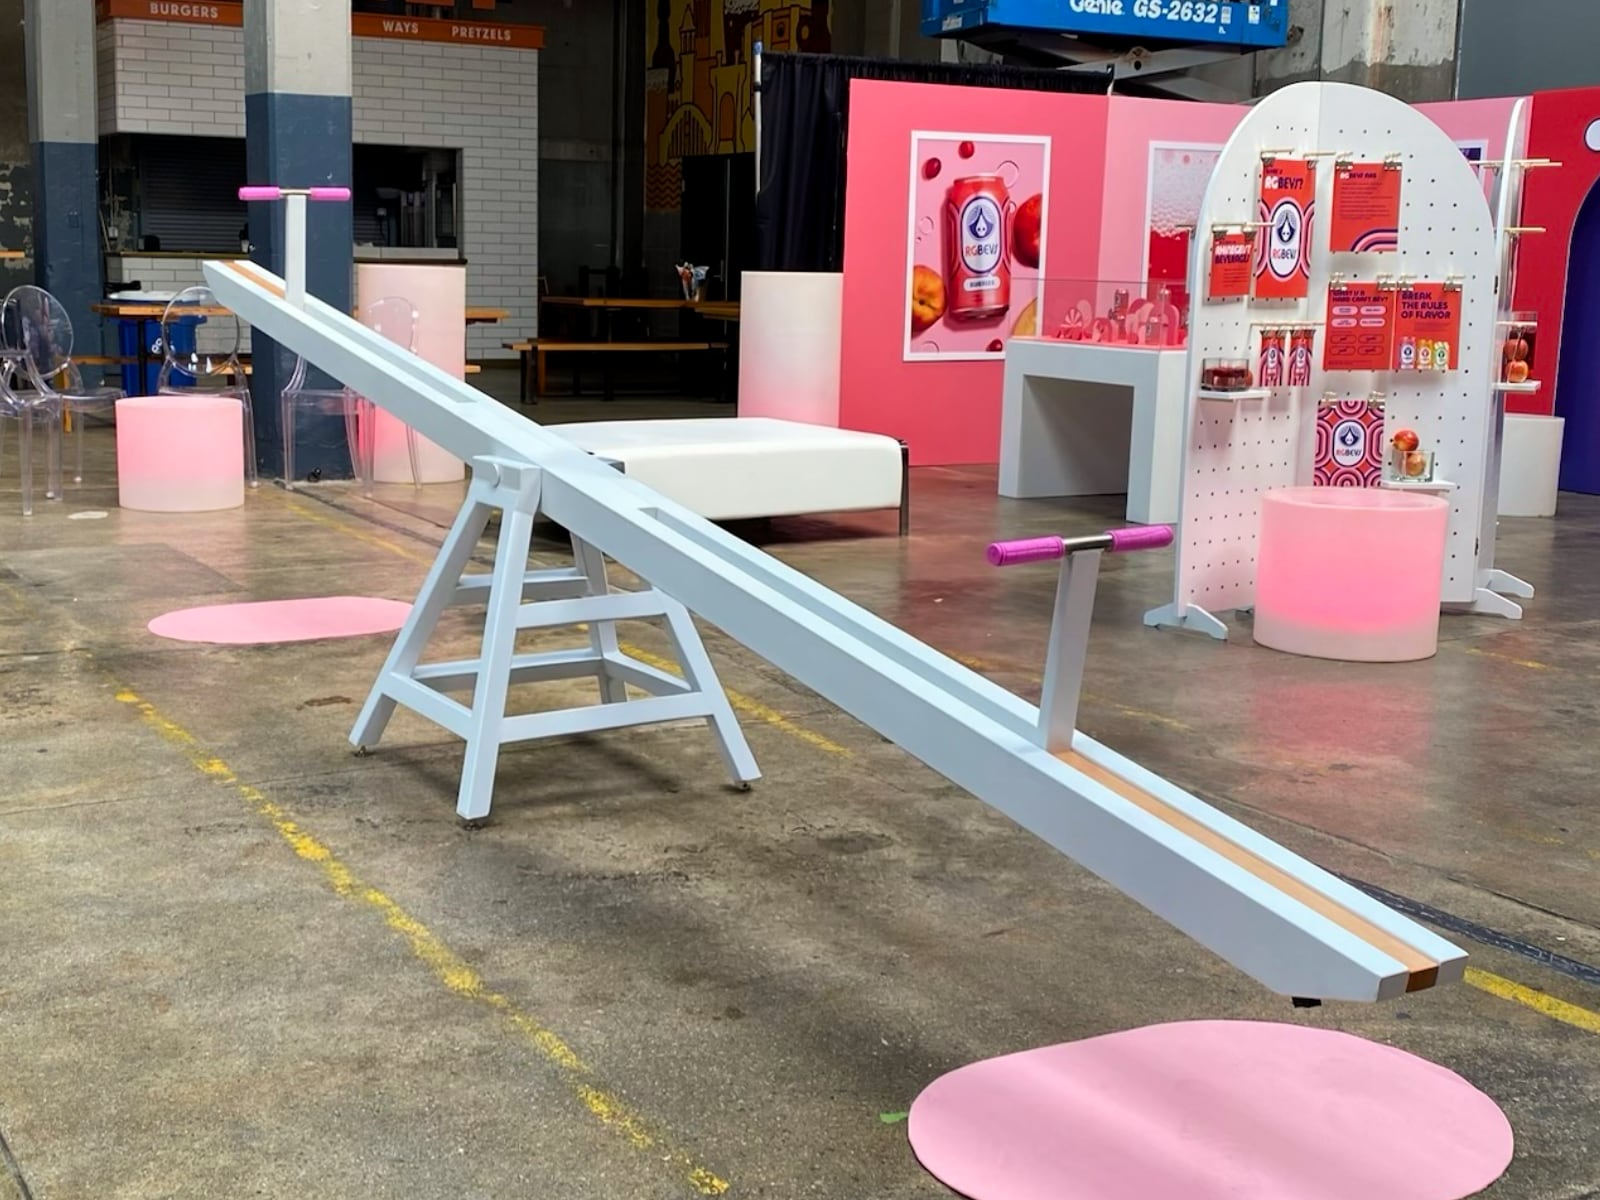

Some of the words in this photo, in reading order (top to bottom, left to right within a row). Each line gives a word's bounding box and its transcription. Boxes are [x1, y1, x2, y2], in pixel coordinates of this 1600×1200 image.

[150, 3, 218, 18] BURGERS
[1070, 0, 1123, 15] Genie
[1133, 0, 1218, 23] GS-2632
[382, 20, 419, 34] WAYS
[451, 25, 512, 42] PRETZELS
[1401, 290, 1432, 300] BREAK
[1402, 301, 1419, 310] THE
[1420, 301, 1449, 311] RULES
[1401, 310, 1413, 319] OF
[1416, 311, 1451, 320] FLAVOR
